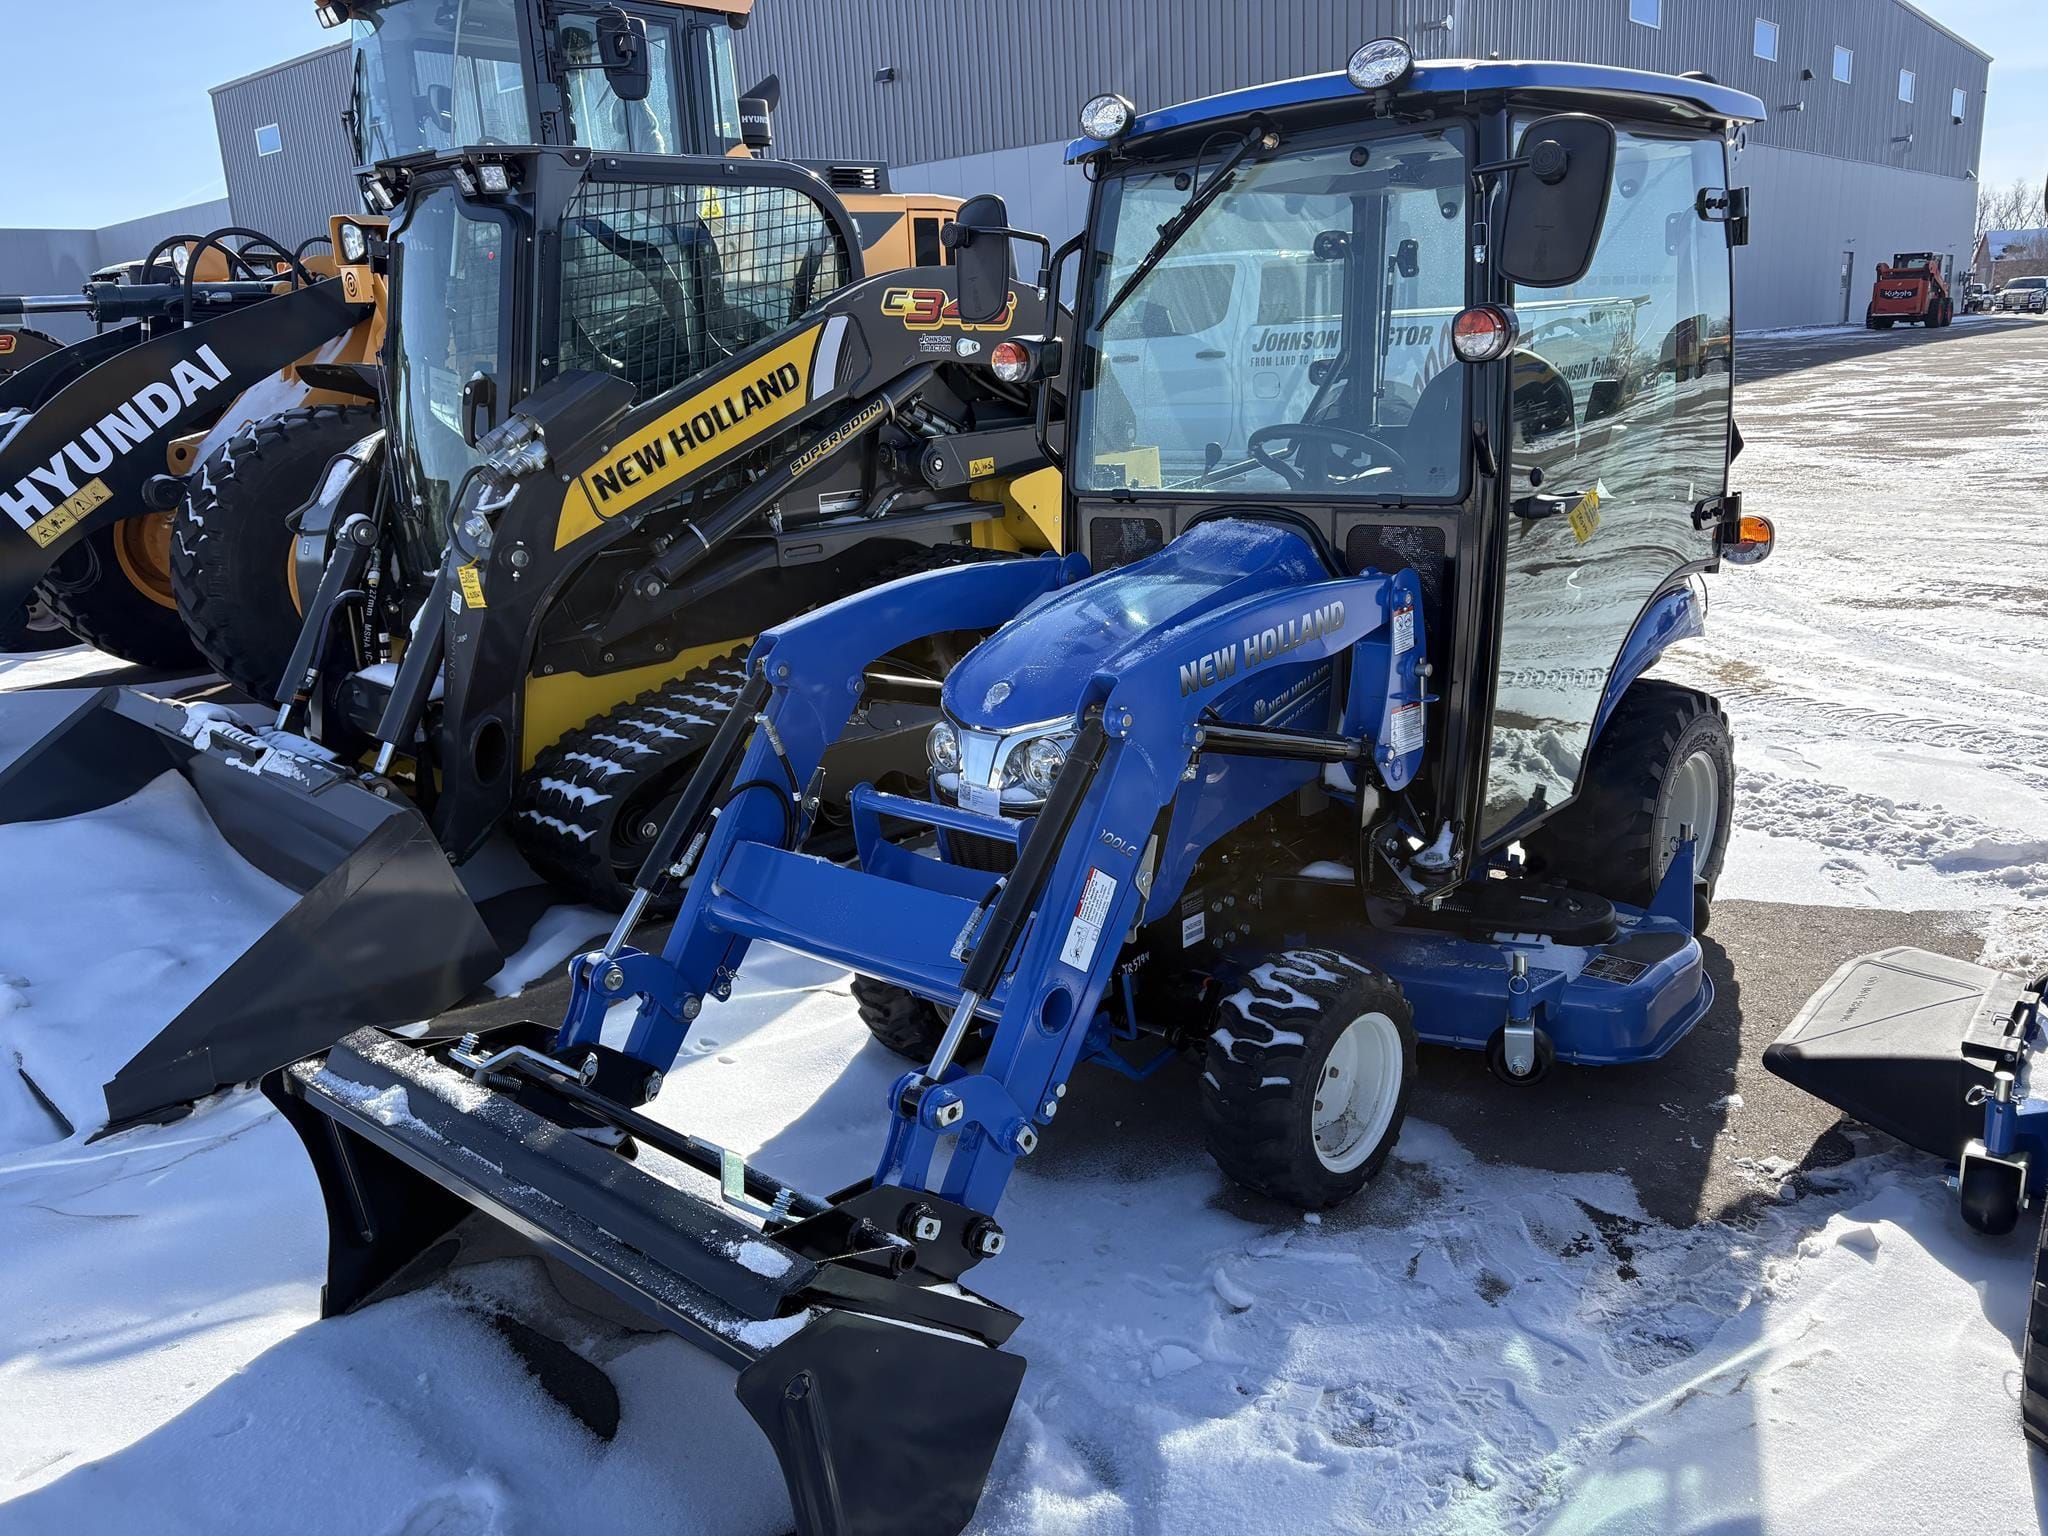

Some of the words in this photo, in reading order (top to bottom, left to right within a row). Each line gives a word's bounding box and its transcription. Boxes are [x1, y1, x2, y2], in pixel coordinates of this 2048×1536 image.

[741, 115, 769, 124] HYUN
[919, 333, 952, 343] JOHNSON
[919, 343, 951, 352] TRACTOR
[1252, 328, 1341, 352] JOHNSON
[1250, 357, 1273, 368] FROM
[1275, 356, 1297, 367] LAND
[1299, 355, 1310, 366] TO
[0, 344, 231, 530] HYUNDAI
[591, 438, 668, 502] NEW
[668, 362, 800, 457] HOLLAND
[790, 431, 841, 476] SUPER
[840, 399, 883, 439] BOOM
[366, 589, 377, 616] 27mm
[363, 624, 372, 648] MSHA
[1179, 643, 1237, 698] NEW
[1243, 600, 1345, 669] HOLLAND
[1268, 690, 1290, 713] NEW
[1098, 828, 1137, 857] 100LC
